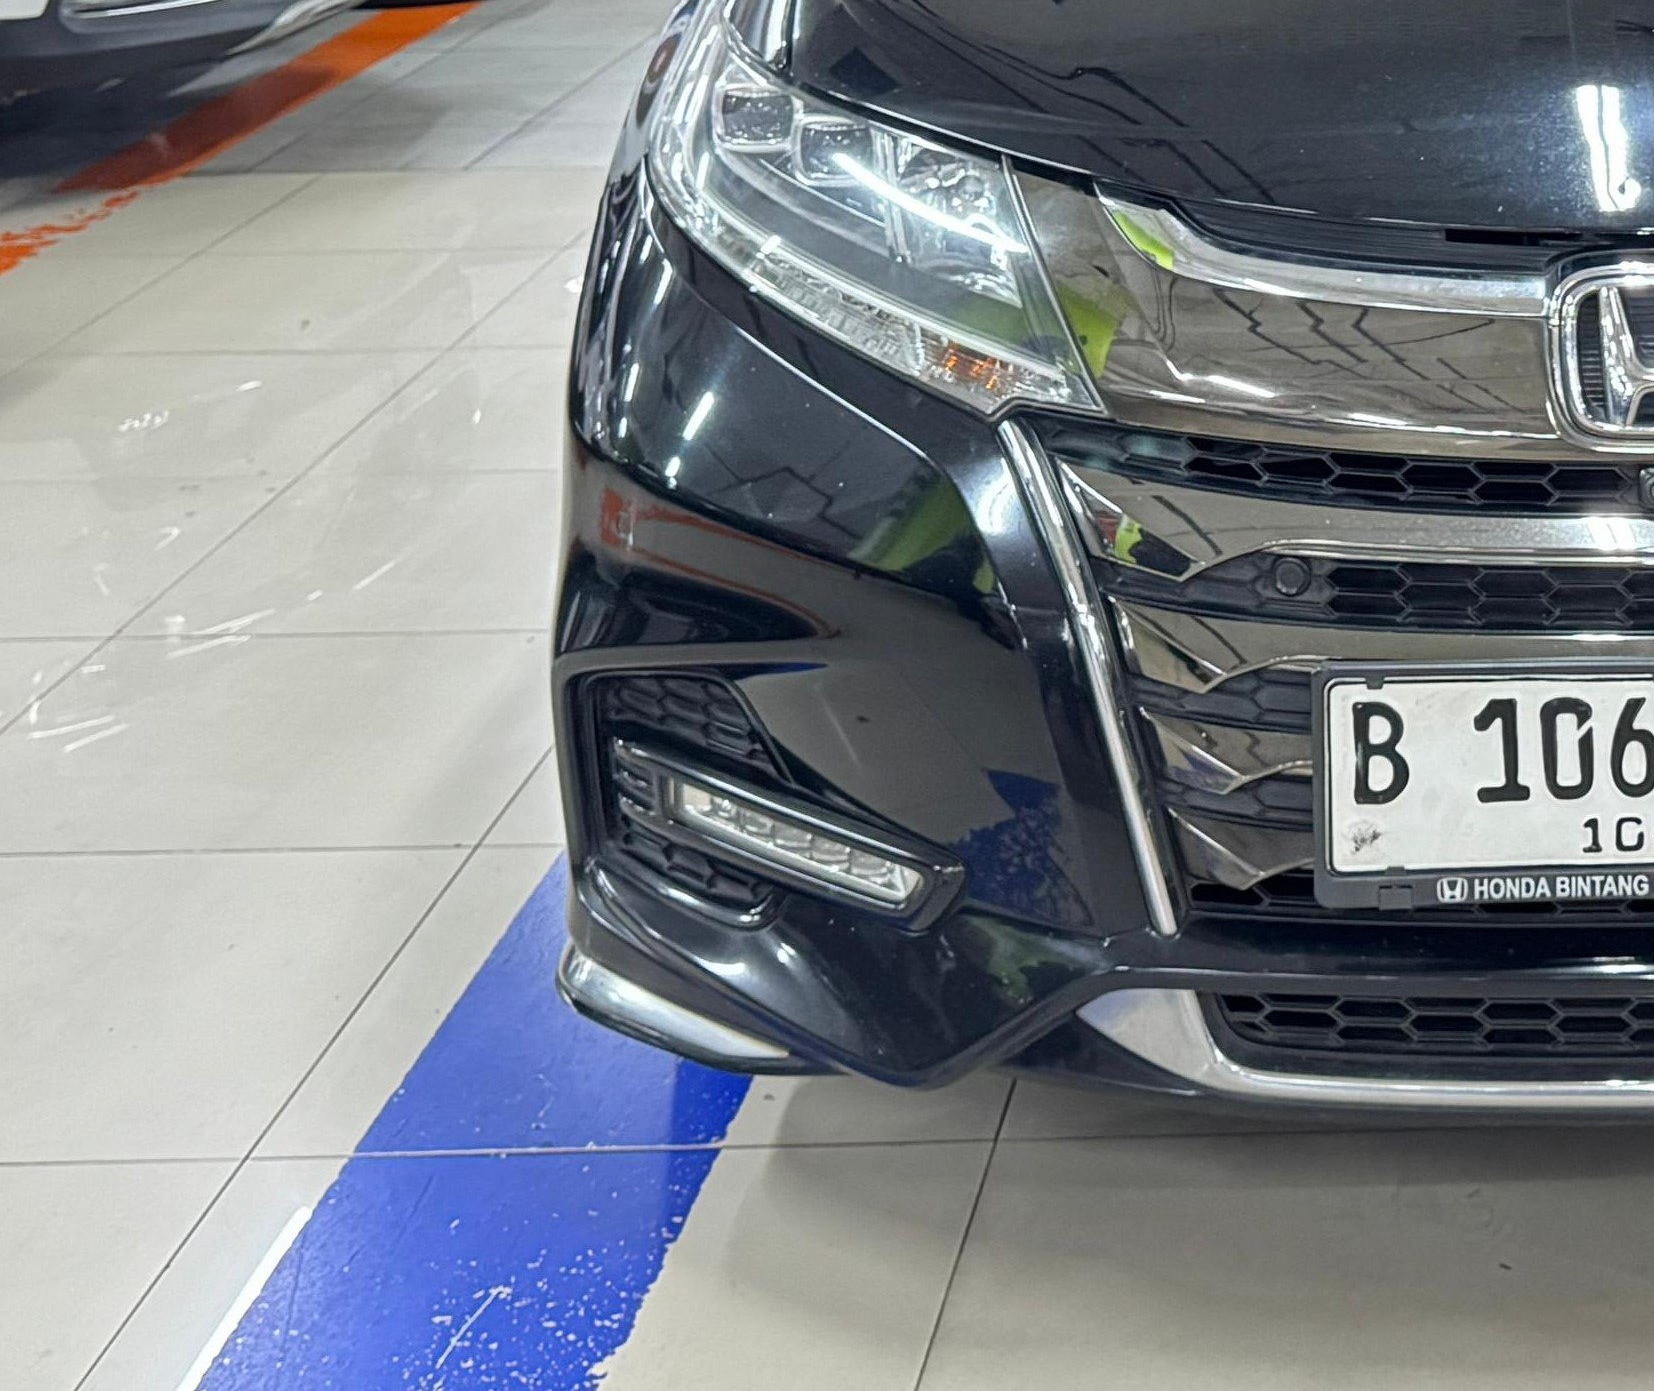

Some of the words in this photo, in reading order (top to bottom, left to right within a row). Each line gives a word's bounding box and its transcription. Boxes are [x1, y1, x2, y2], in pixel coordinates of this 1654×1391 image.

[1353, 702, 1410, 805] B
[1474, 876, 1552, 900] HONDA
[1555, 874, 1650, 898] BINTANG
